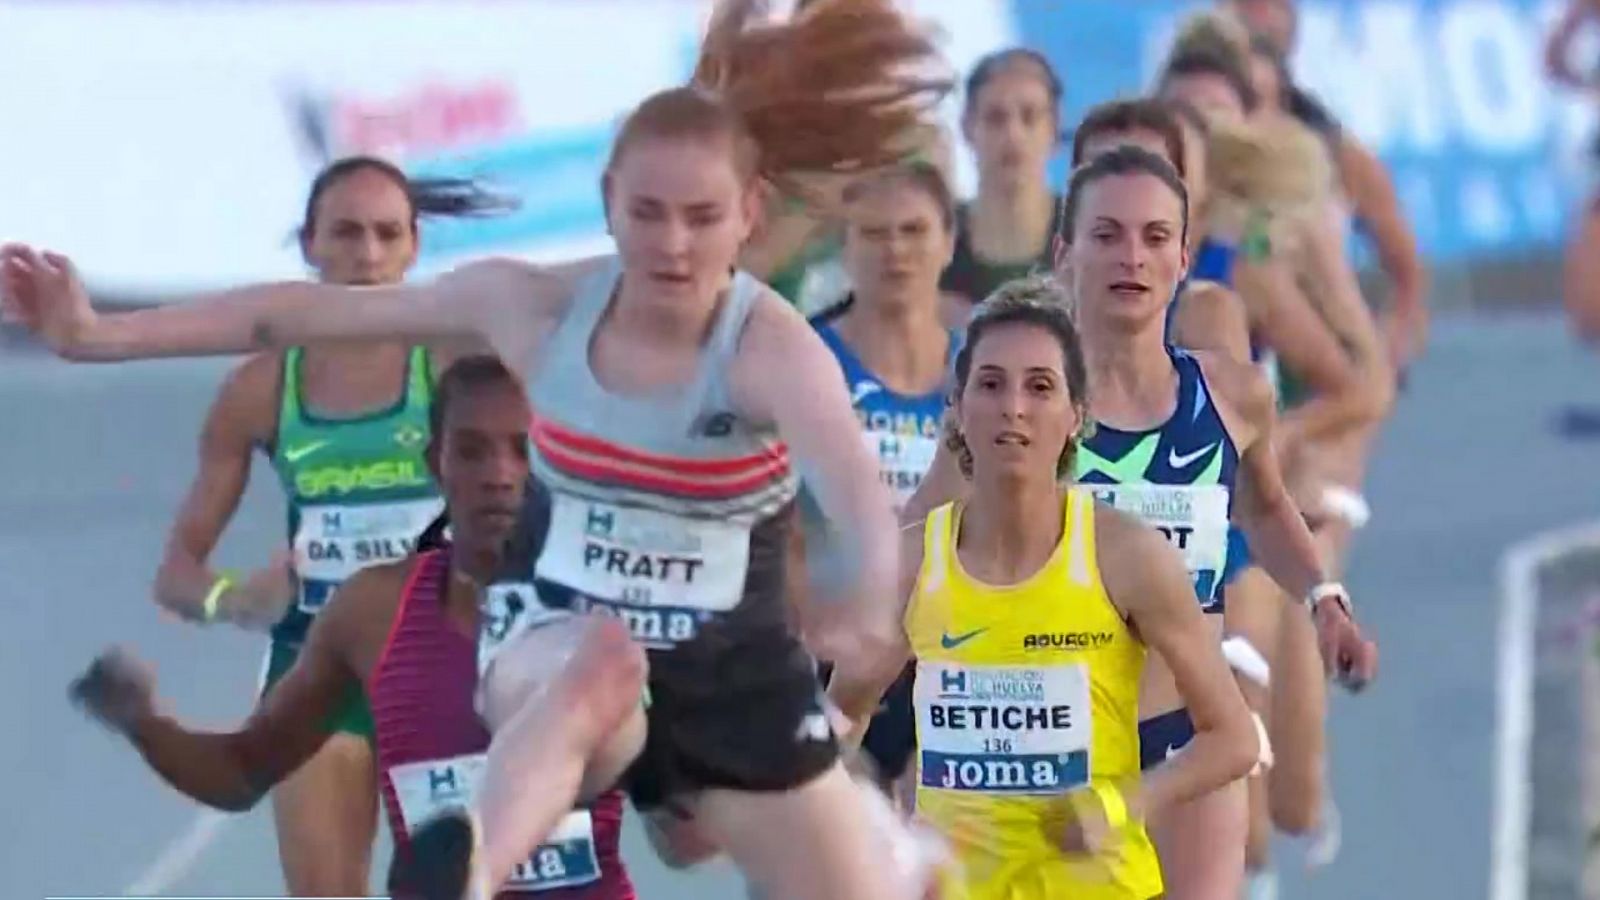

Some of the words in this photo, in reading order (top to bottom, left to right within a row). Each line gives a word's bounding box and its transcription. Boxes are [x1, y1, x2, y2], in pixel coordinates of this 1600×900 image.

[295, 461, 426, 496] BRASIL
[307, 541, 342, 561] DA
[583, 542, 703, 583] PRATT
[929, 704, 1072, 730] BETICHE
[983, 738, 1012, 753] 136
